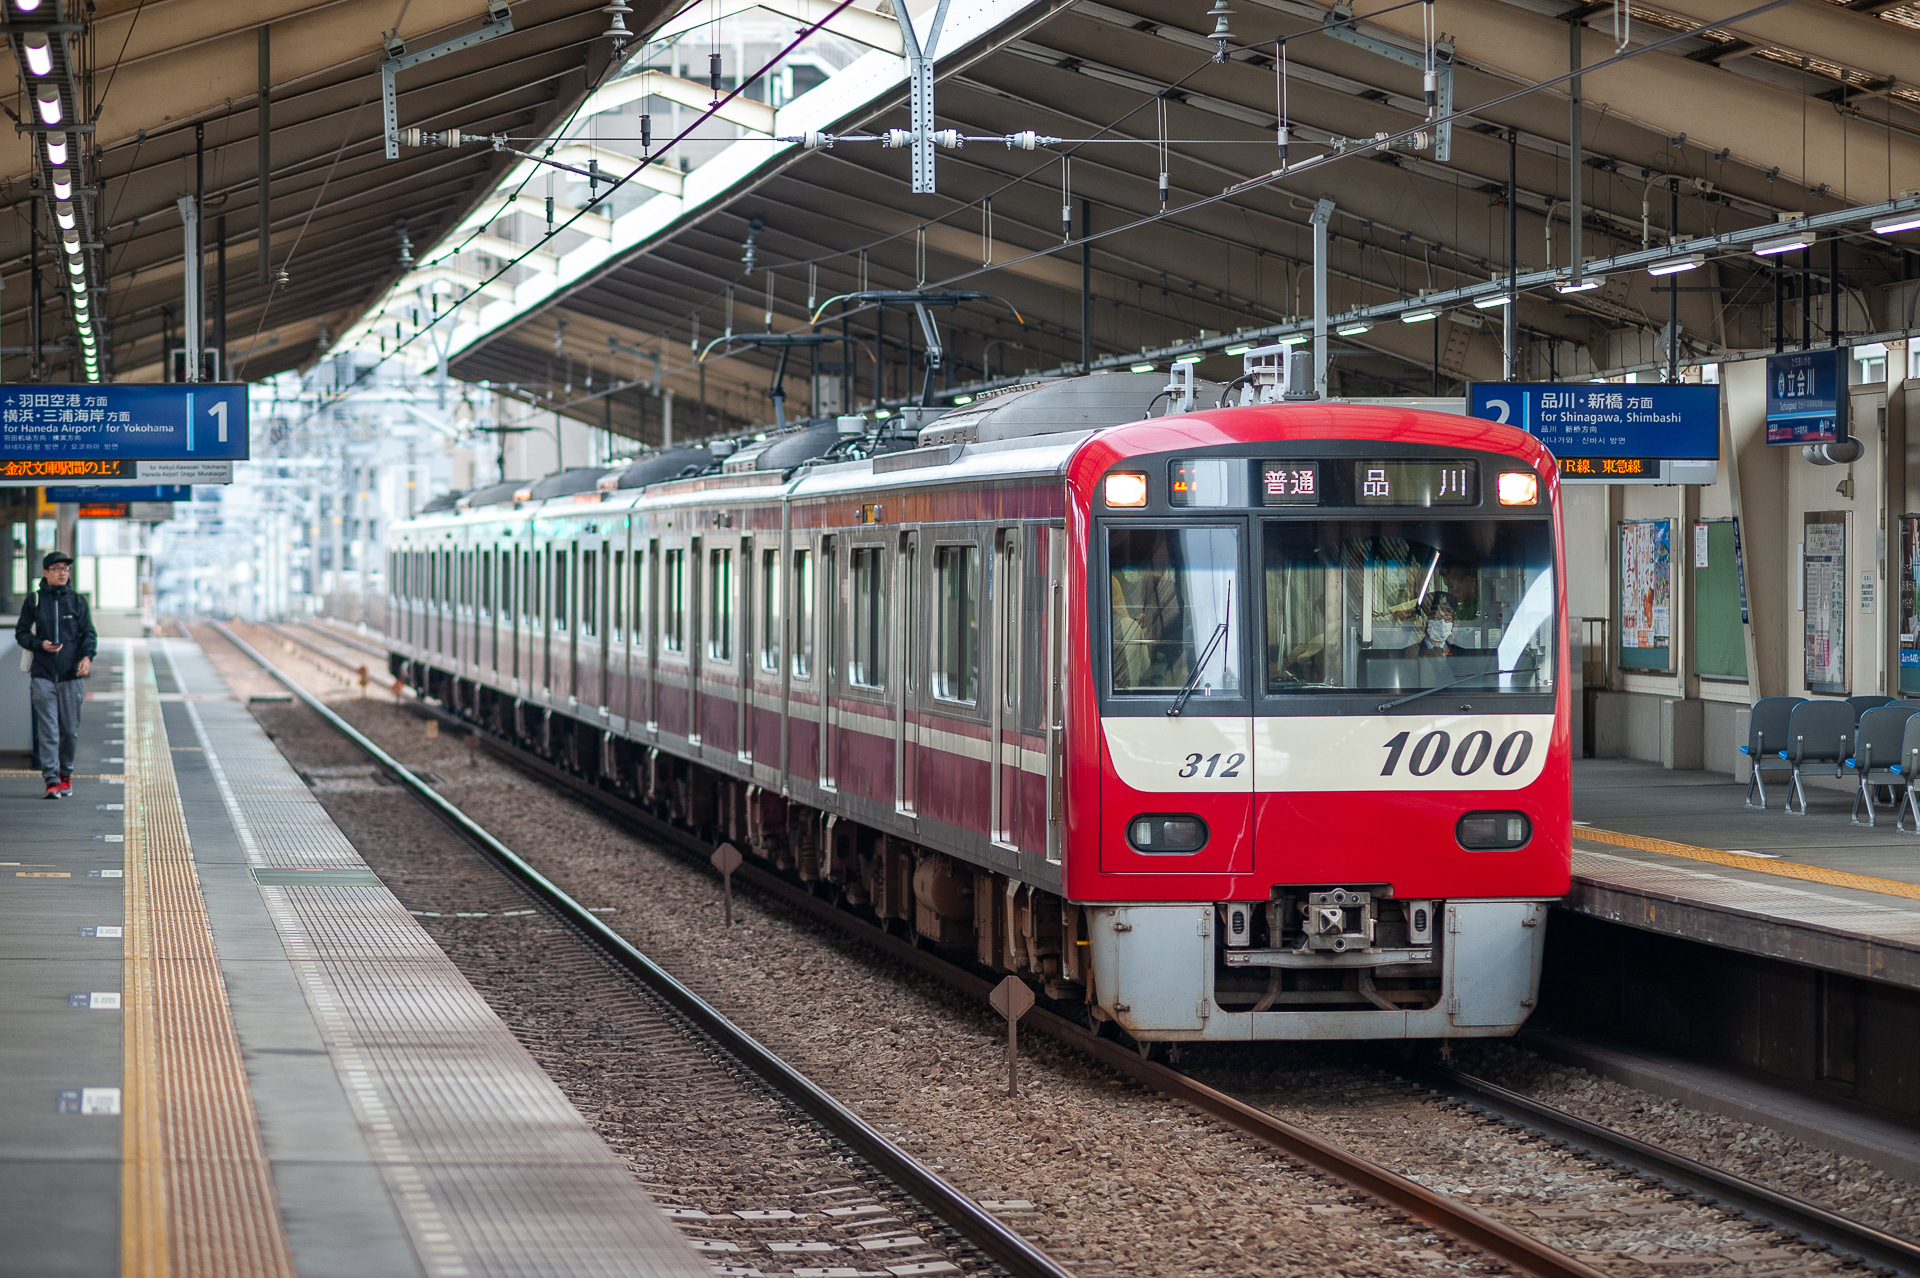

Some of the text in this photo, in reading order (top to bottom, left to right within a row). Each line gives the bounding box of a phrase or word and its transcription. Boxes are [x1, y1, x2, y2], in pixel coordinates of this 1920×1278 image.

[1787, 368, 1815, 397] 立会川
[19, 393, 108, 407] 羽田空港 方面
[1485, 399, 1510, 425] 2
[1541, 392, 1653, 409] 品川・新橋 方面
[3, 409, 130, 422] 横浜・三浦海岸 方面
[207, 401, 228, 442] 1
[1541, 411, 1682, 425] for Shinagawa, Shimbashi
[3, 424, 18, 433] for
[21, 424, 58, 433] Haneda
[61, 424, 96, 435] Airport
[106, 424, 120, 433] for
[123, 424, 174, 433] Yokohama
[1264, 470, 1315, 495] 普通
[1177, 752, 1246, 778] 312
[1379, 730, 1534, 777] 1000
